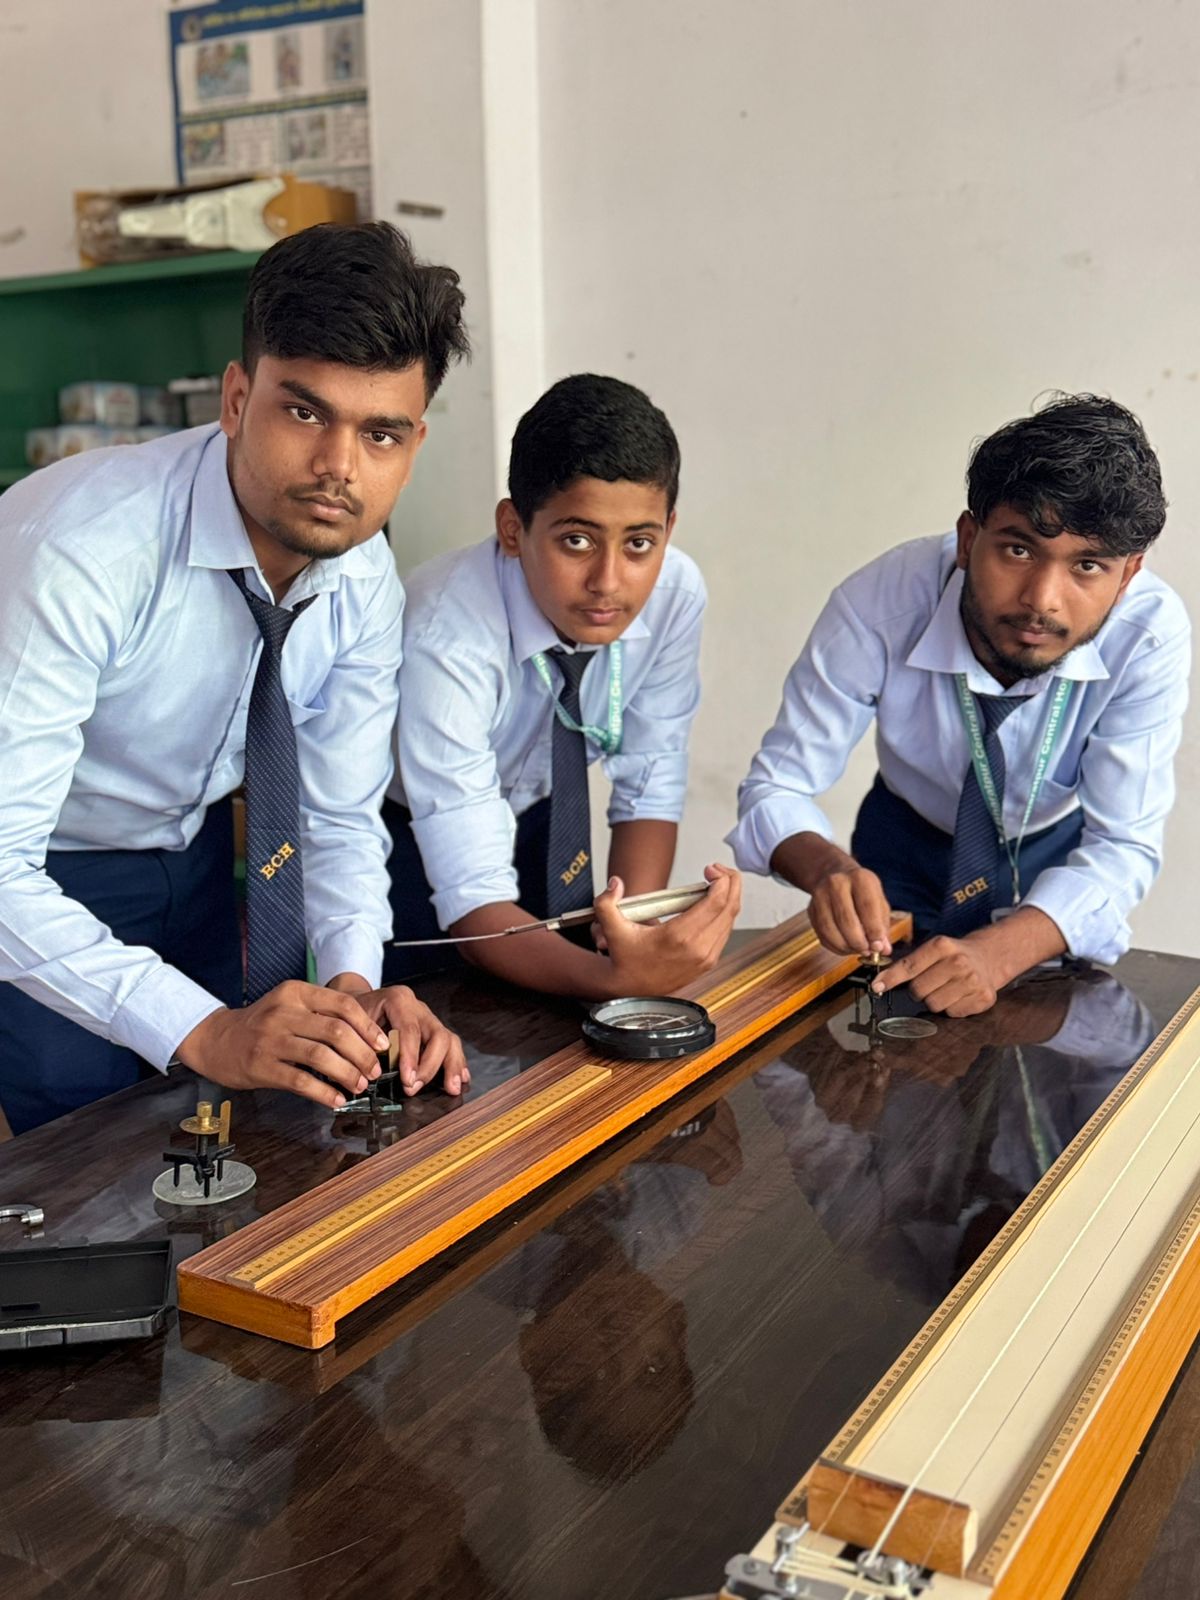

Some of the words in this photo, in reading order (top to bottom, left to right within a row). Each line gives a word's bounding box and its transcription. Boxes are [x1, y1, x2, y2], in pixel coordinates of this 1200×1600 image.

[967, 709, 986, 759] Central
[1039, 706, 1062, 755] Central
[259, 842, 296, 880] BCH
[560, 850, 589, 886] BCH
[953, 876, 989, 905] BCH
